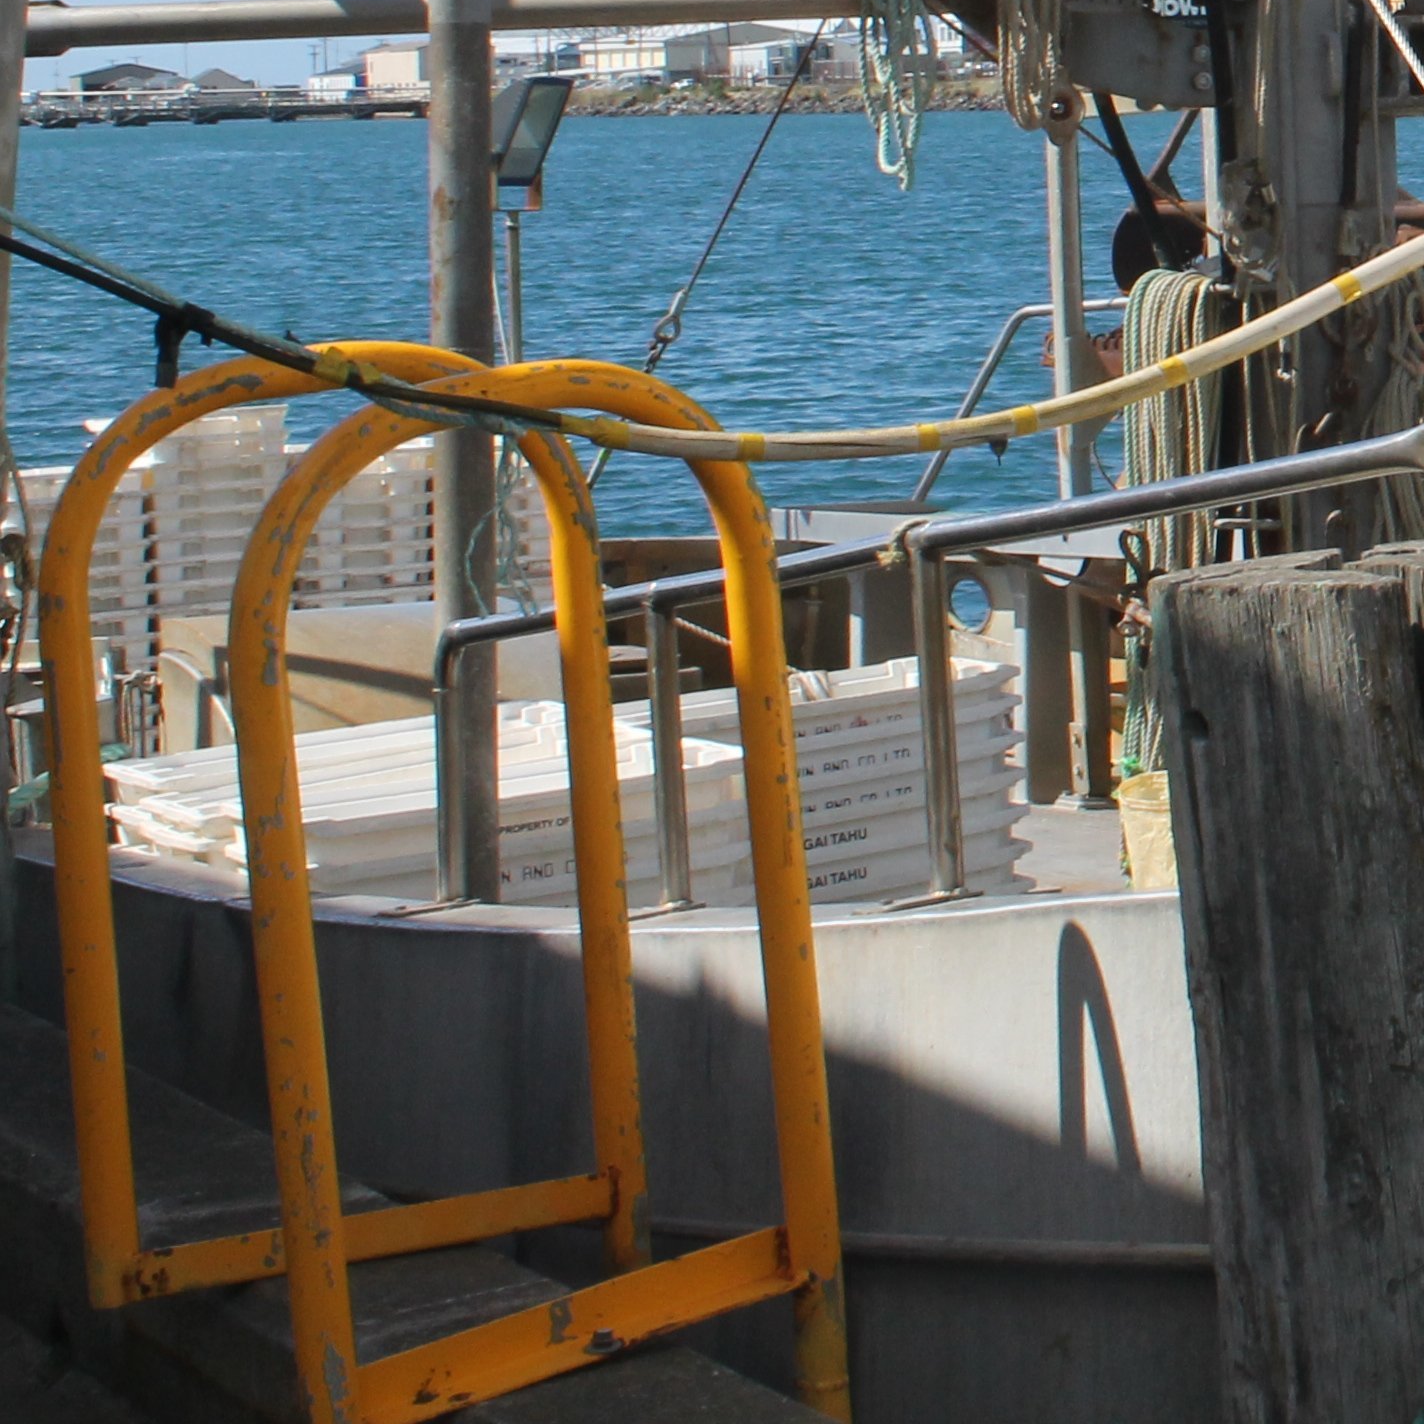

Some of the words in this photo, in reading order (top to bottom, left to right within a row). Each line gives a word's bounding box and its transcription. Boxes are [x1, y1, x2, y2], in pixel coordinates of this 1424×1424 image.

[497, 819, 553, 834] PROPERTY
[830, 827, 867, 845] TAHU
[522, 862, 554, 881] AND
[830, 866, 867, 885] TAHU
